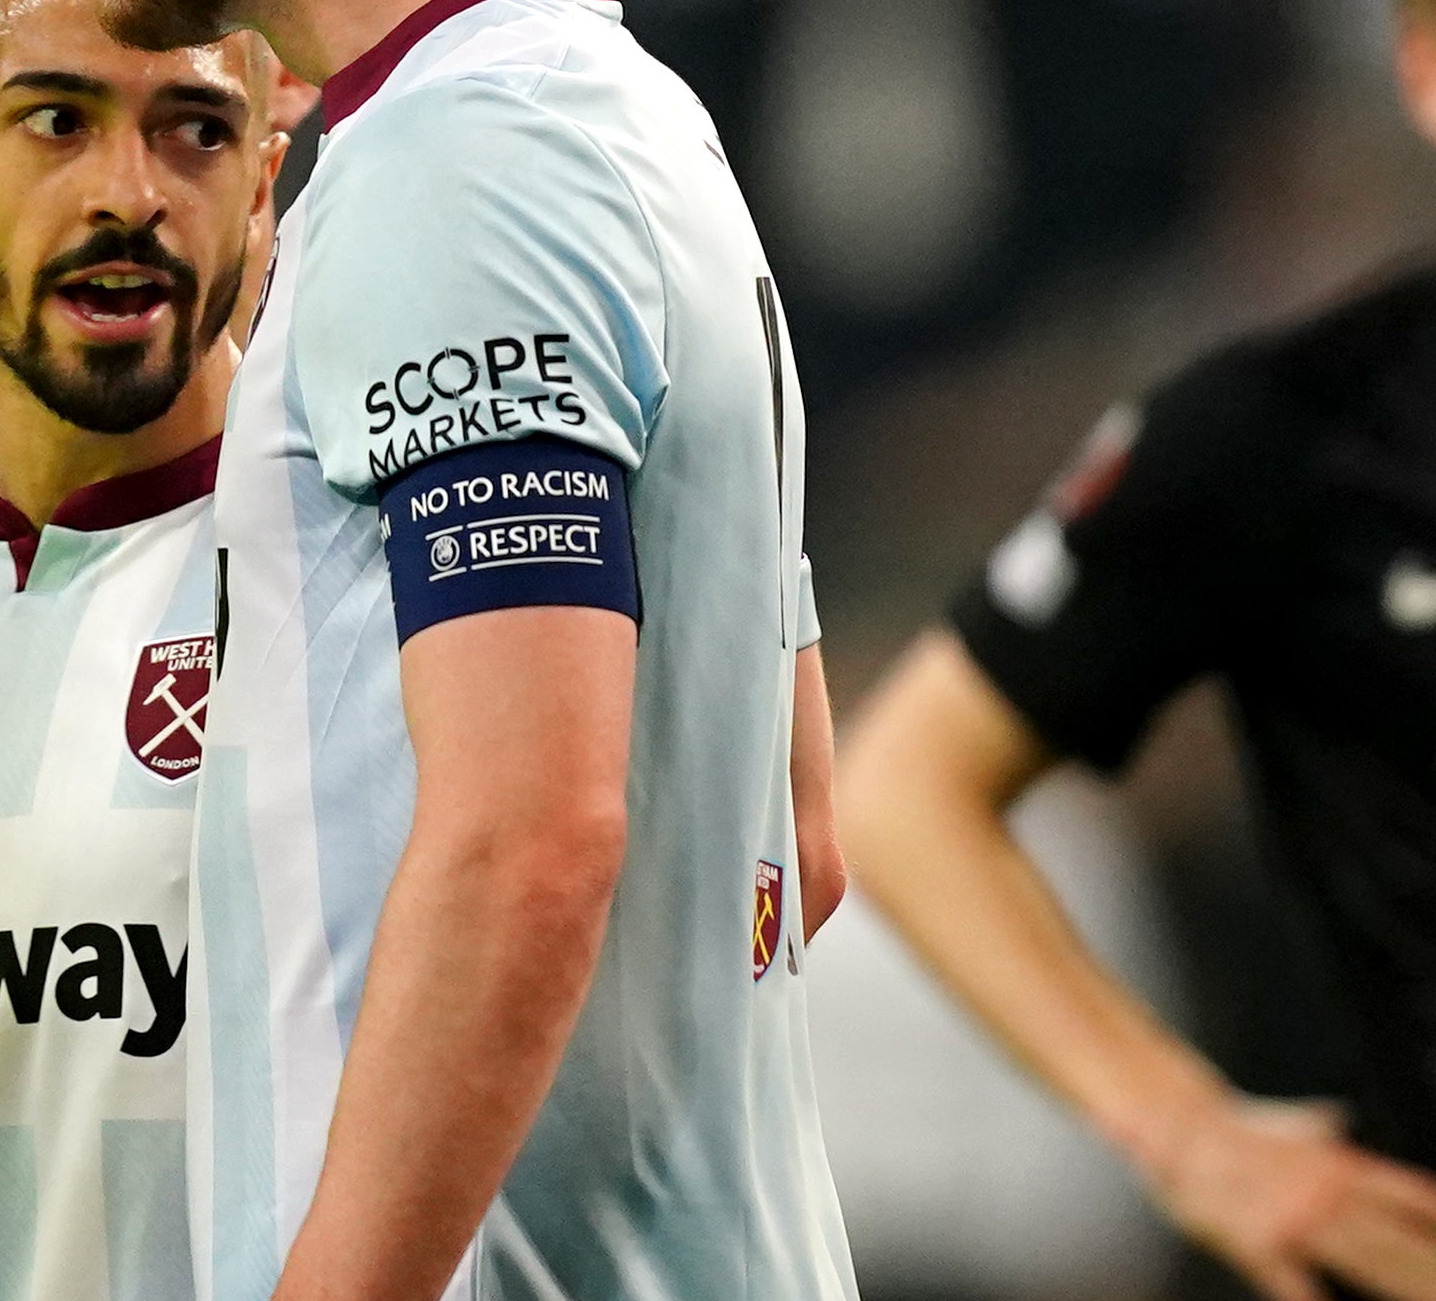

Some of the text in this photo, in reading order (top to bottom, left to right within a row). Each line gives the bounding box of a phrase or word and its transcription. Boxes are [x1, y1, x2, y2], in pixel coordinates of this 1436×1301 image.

[365, 333, 573, 435] SCOPE
[368, 391, 587, 482] MARKETS
[410, 470, 610, 522] NO TO RACISM
[469, 524, 601, 560] RESPECT
[150, 640, 204, 664] WEST
[167, 655, 213, 672] UNITE
[150, 755, 200, 770] LONDON
